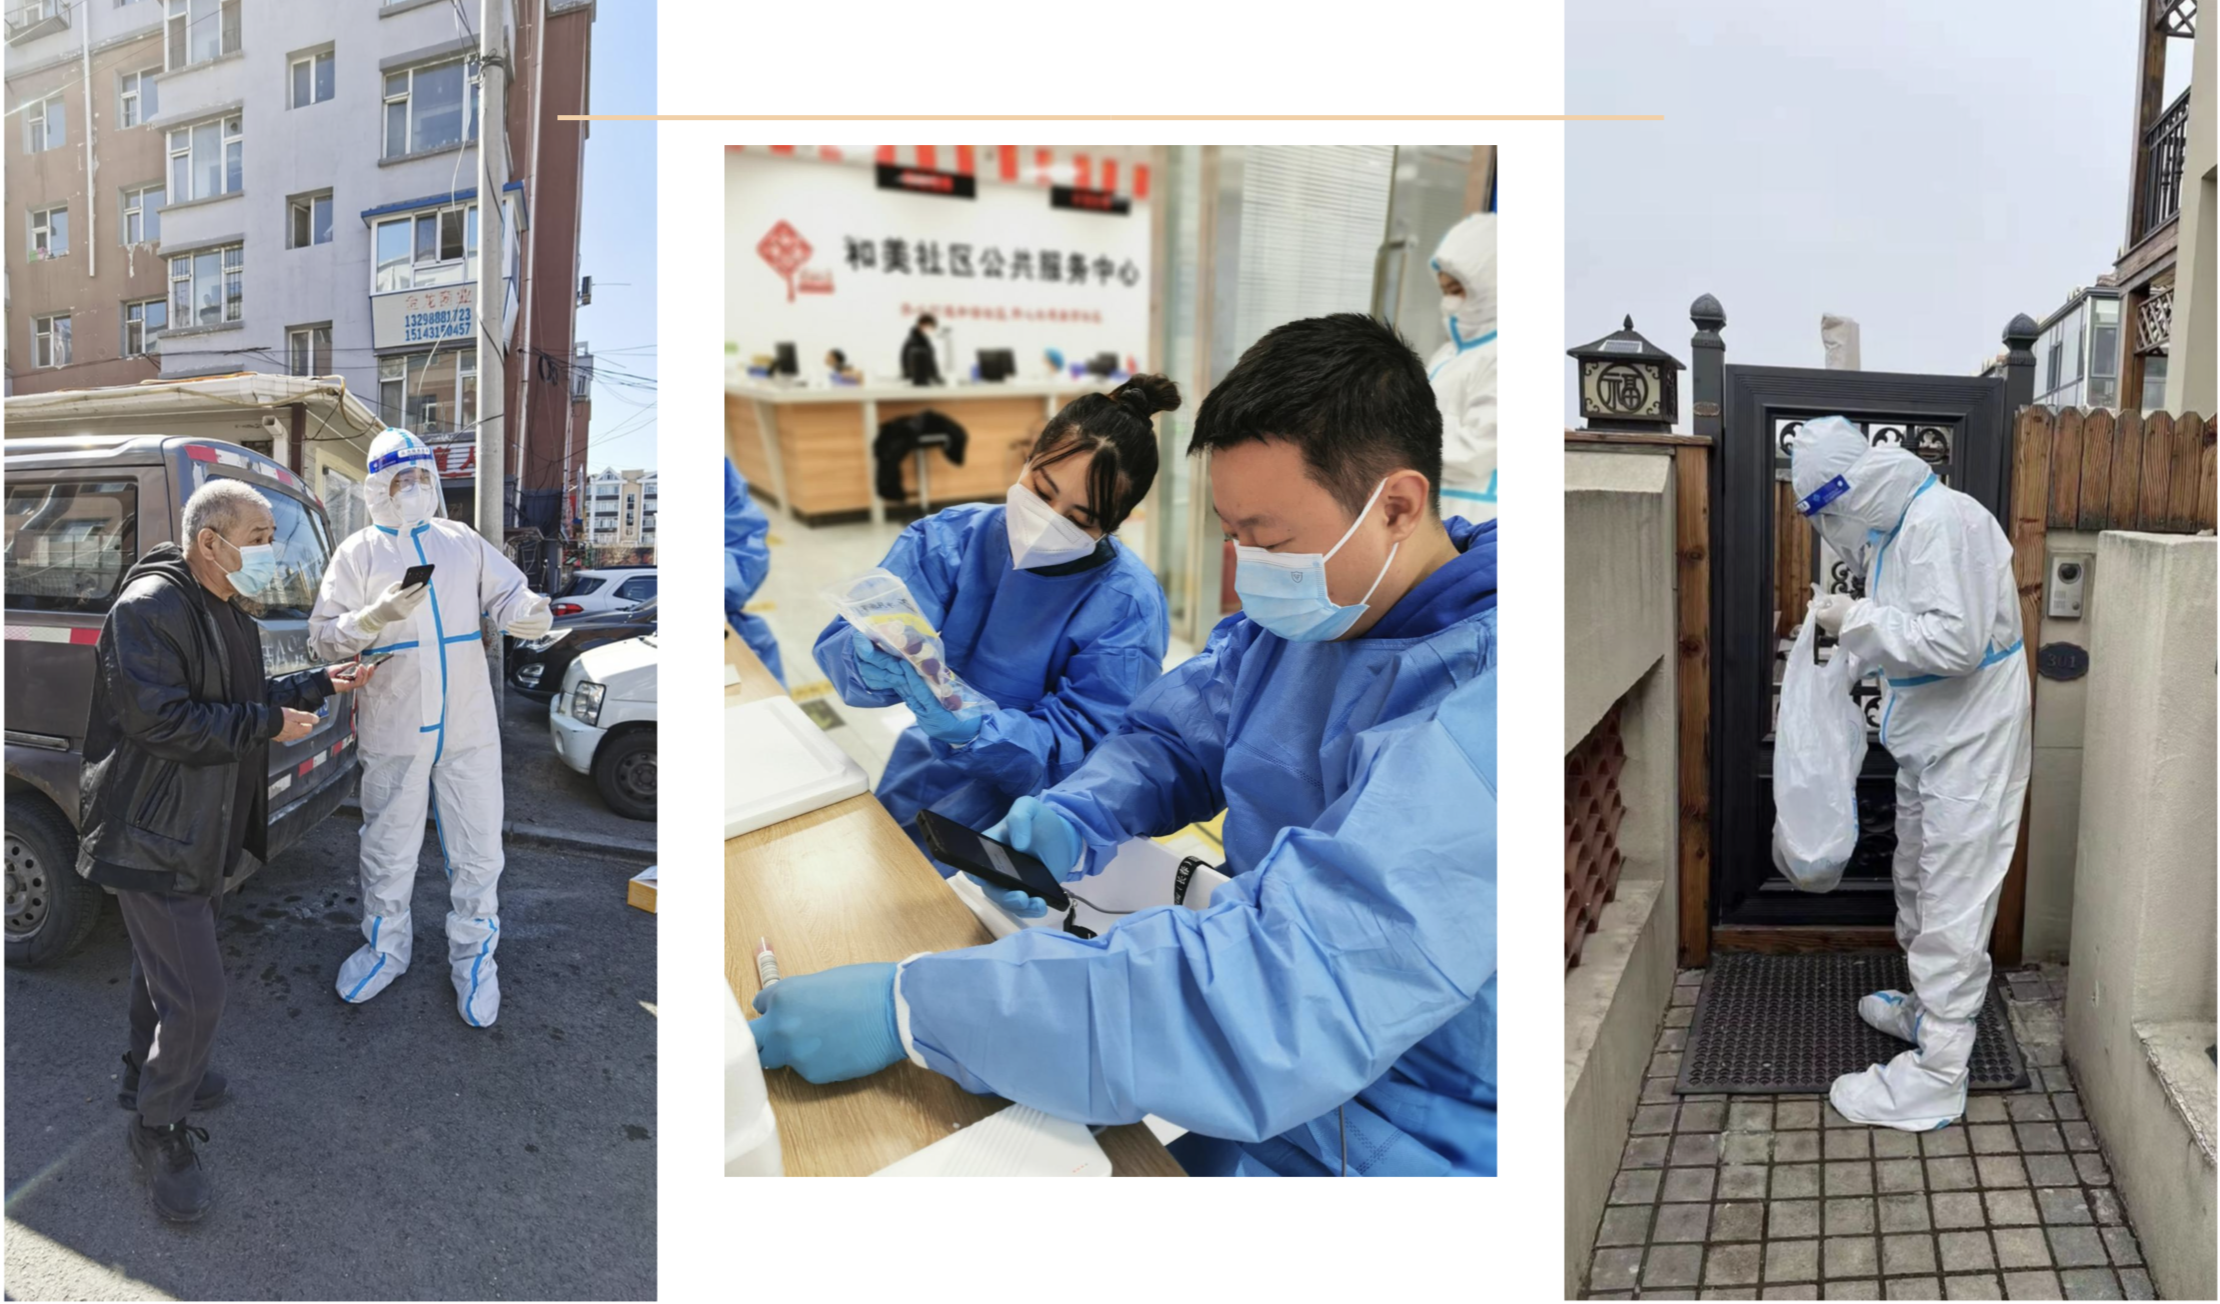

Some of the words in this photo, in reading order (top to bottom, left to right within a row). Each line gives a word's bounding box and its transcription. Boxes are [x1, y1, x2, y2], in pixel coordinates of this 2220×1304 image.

[844, 235, 1141, 288] 和美社区公共服务中心
[404, 307, 471, 328] 13298881723
[404, 322, 471, 341] 15143150457
